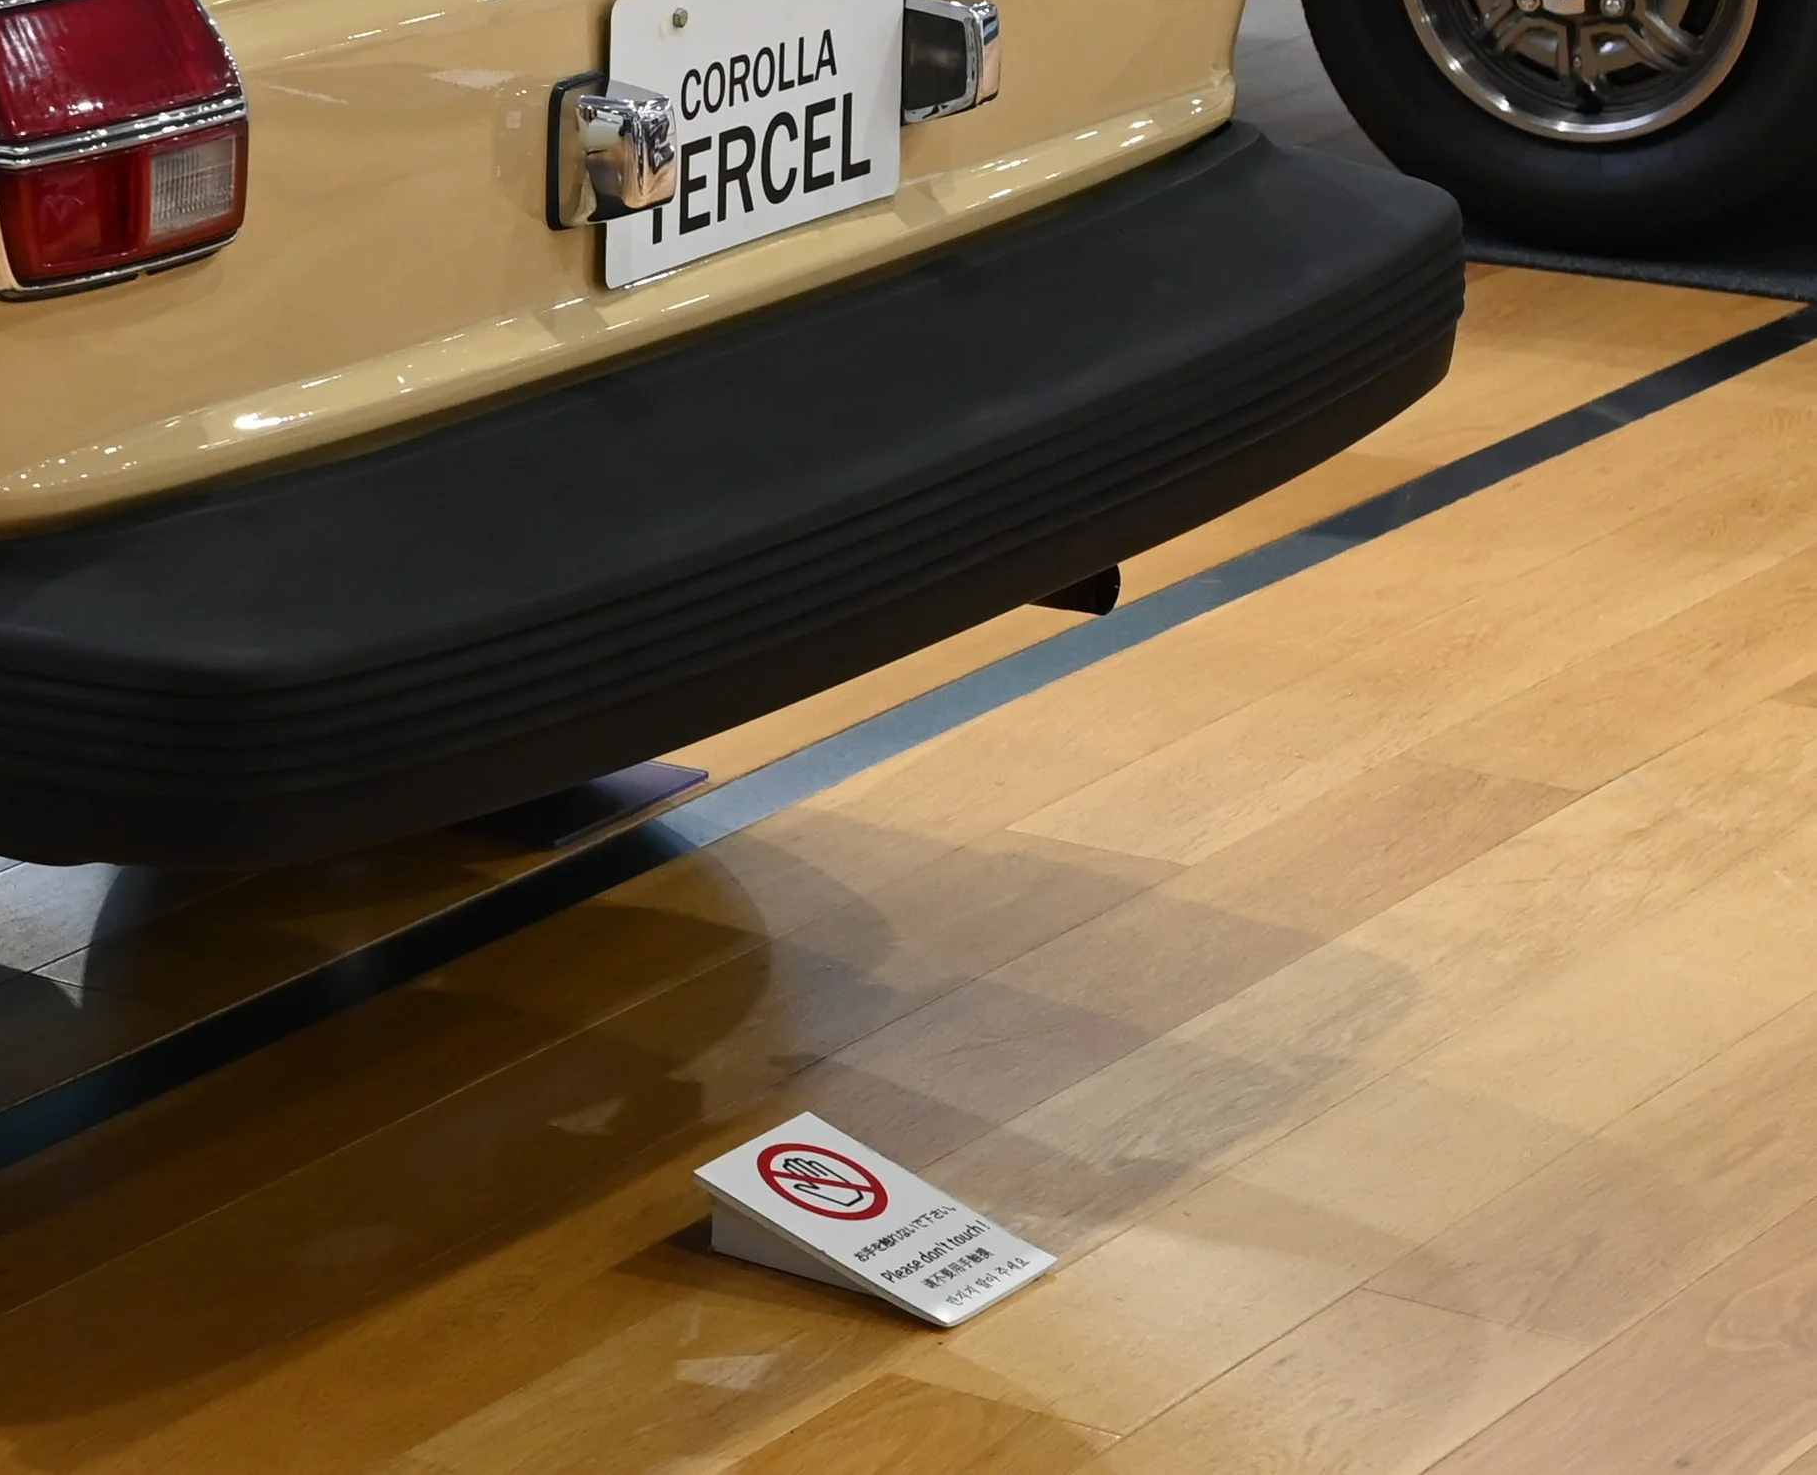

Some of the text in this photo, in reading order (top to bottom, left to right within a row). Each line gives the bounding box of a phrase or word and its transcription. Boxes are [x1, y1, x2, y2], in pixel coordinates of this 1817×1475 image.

[680, 28, 838, 121] COROLLA
[651, 92, 872, 246] ERCEL
[880, 1258, 925, 1284] Please
[918, 1239, 955, 1265] don't
